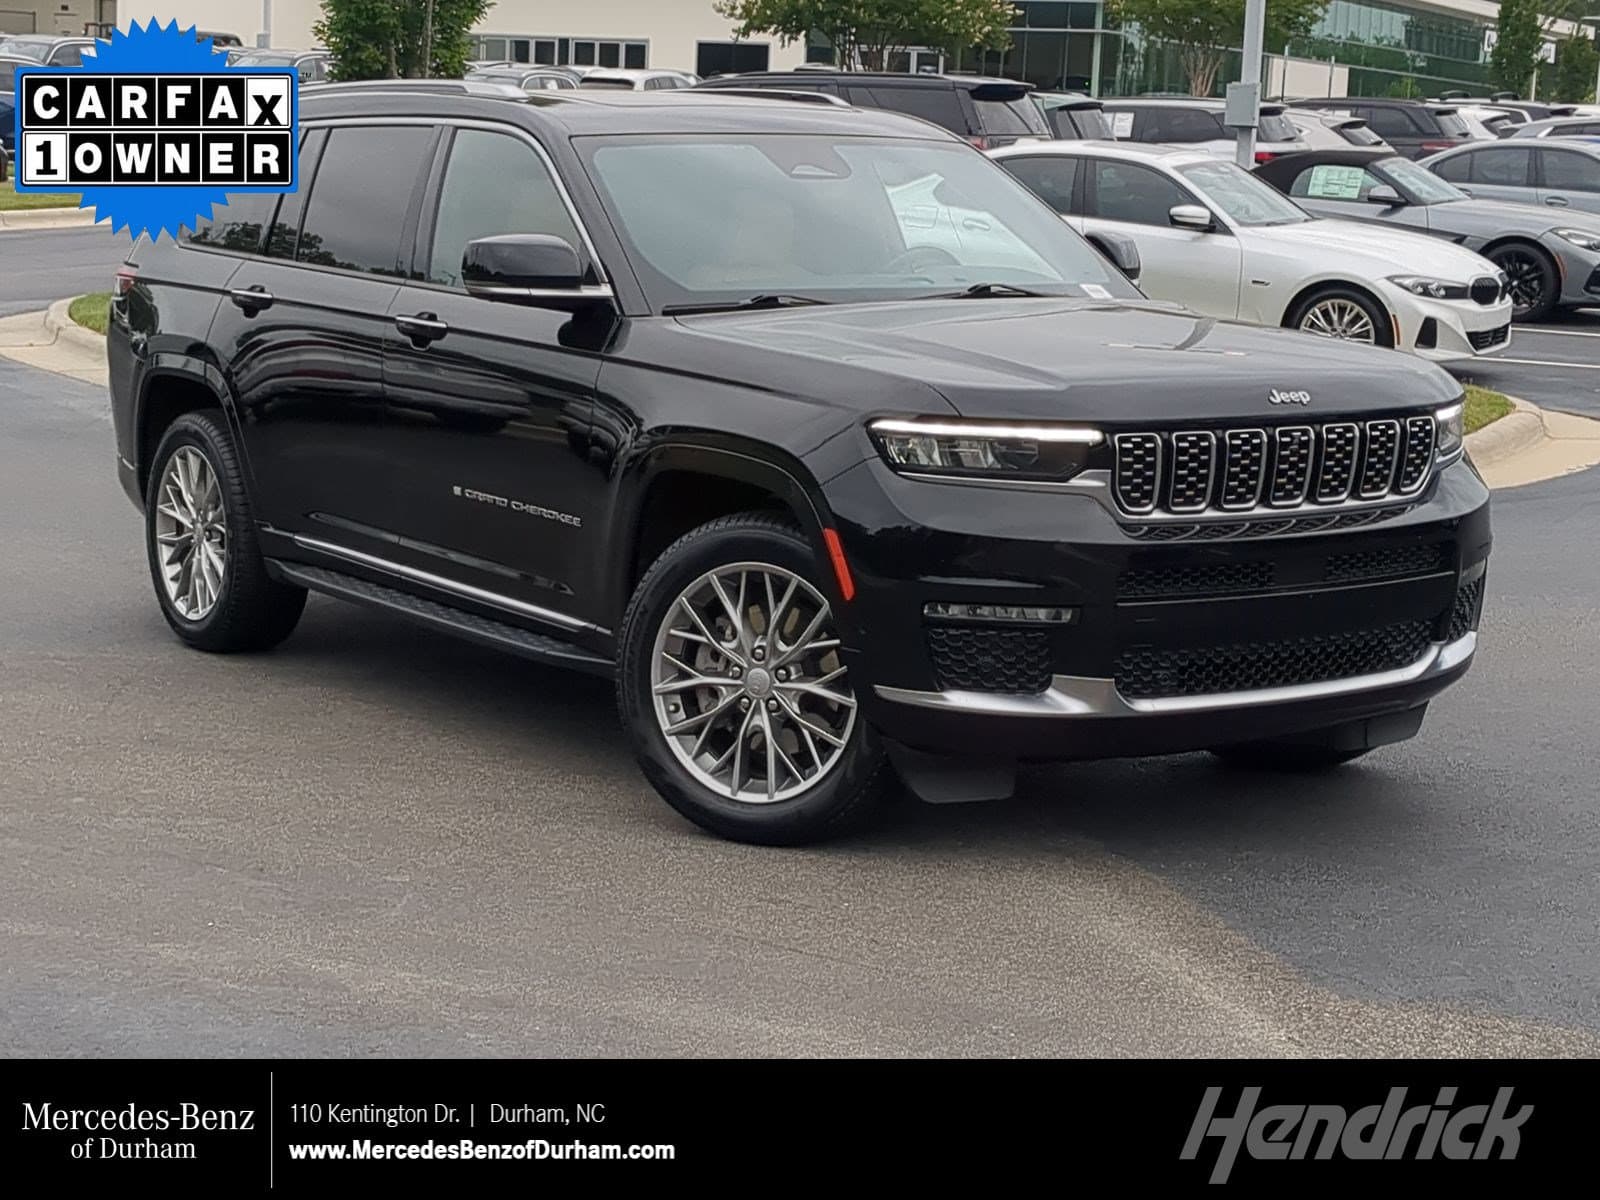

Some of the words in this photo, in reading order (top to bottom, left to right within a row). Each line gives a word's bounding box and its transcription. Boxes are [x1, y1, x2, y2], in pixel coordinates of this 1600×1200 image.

[1269, 389, 1311, 405] Jeep
[464, 488, 508, 507] GRAND
[510, 500, 582, 527] CHEROKEE
